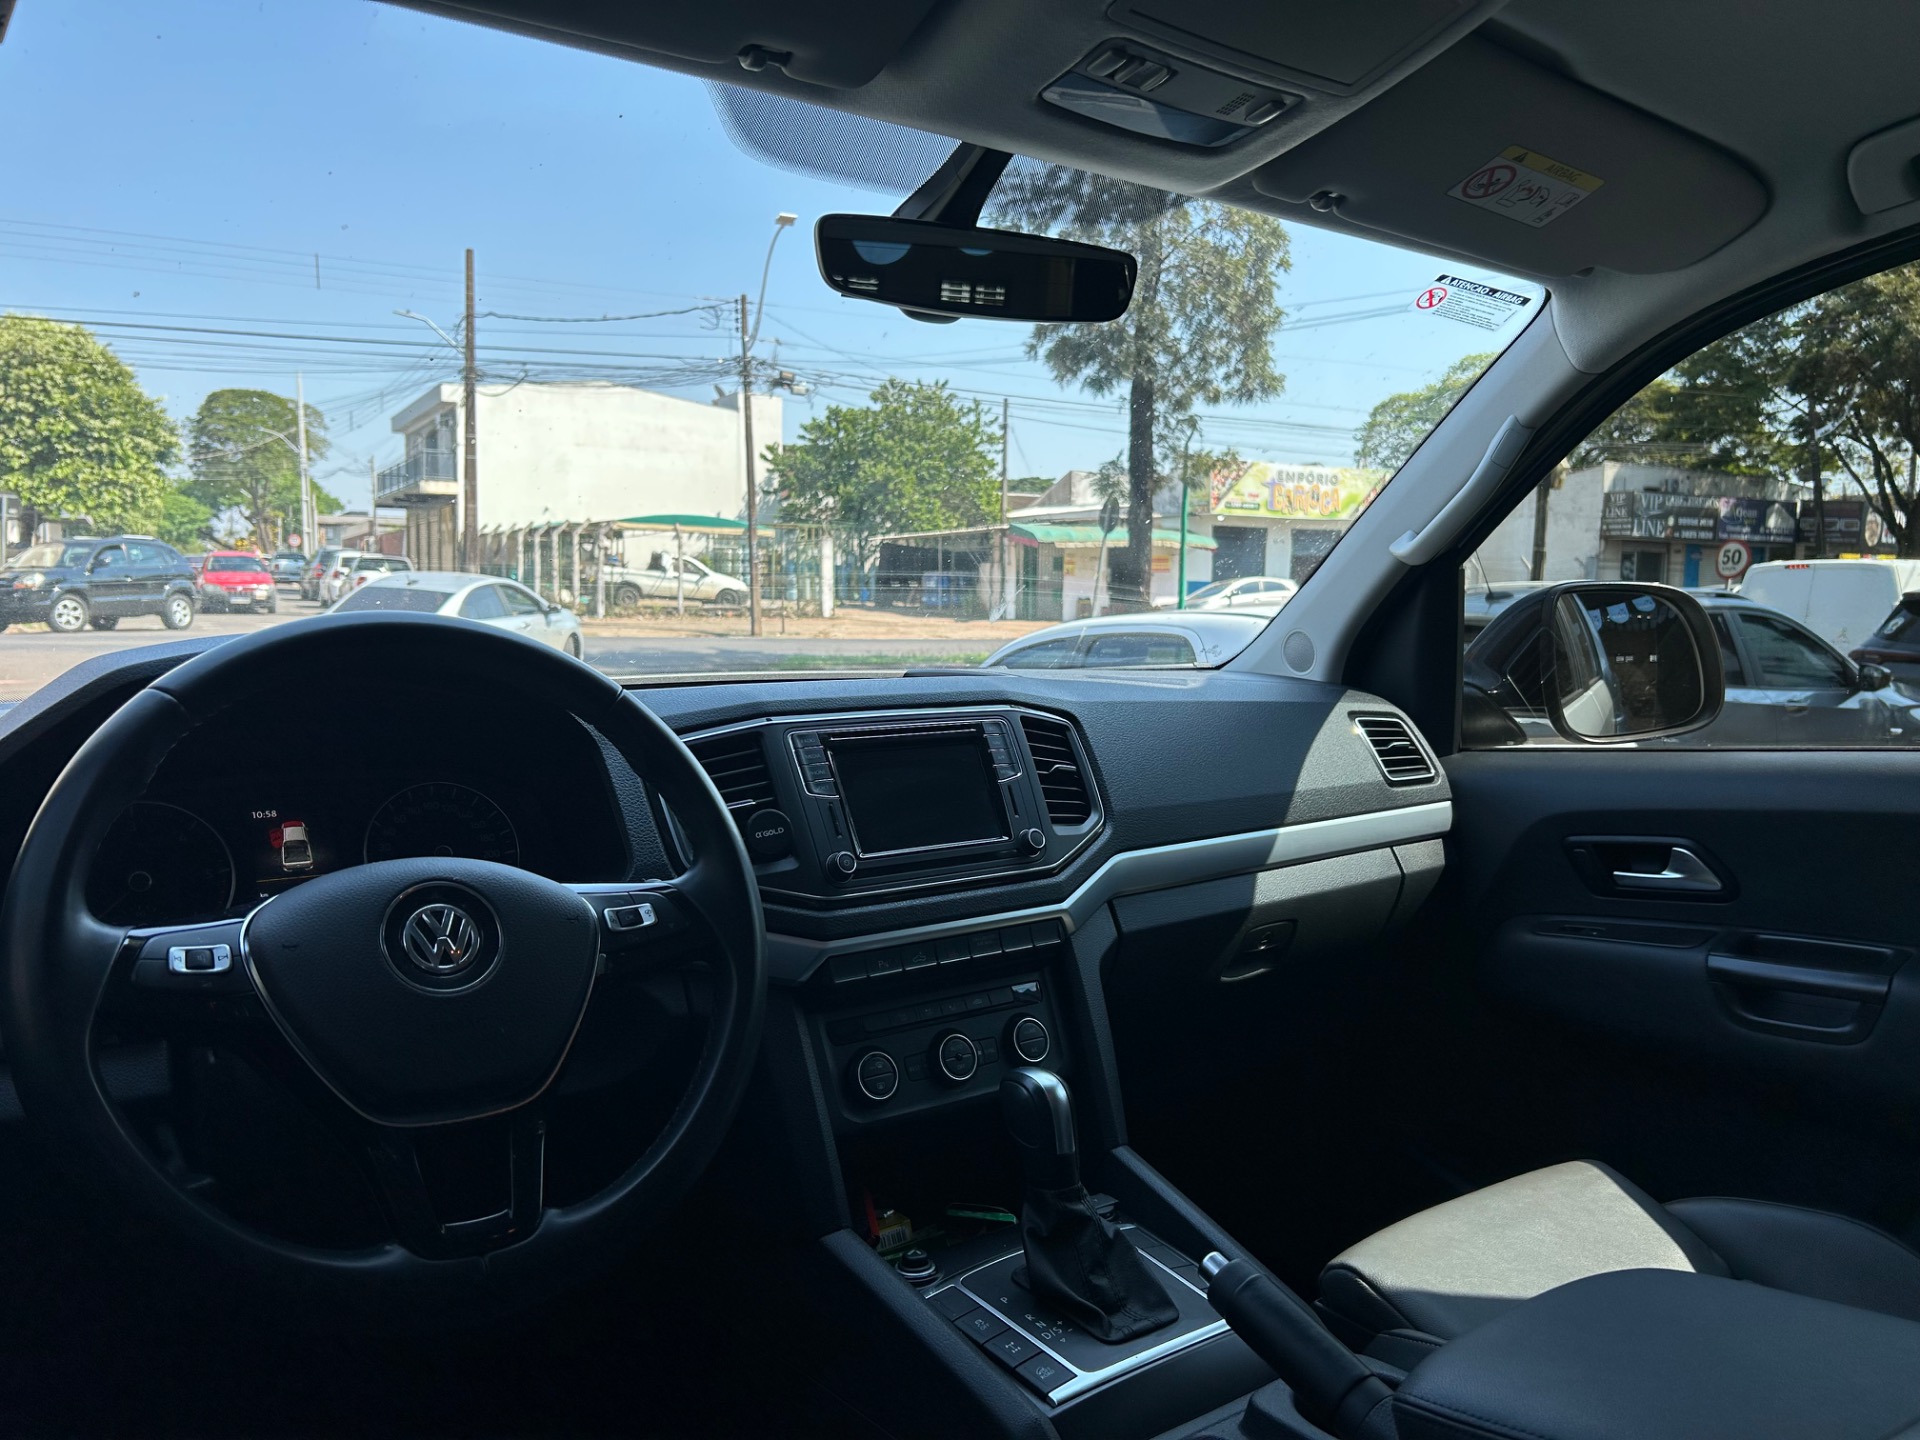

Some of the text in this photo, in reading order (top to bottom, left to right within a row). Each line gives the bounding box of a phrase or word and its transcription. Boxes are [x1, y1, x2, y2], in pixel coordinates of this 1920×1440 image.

[1543, 163, 1582, 182] AIRBAG
[1493, 291, 1524, 305] AIRBAG
[1273, 482, 1341, 516] CARIOCA
[1640, 493, 1663, 511] VIP
[1722, 549, 1742, 565] 50
[251, 809, 278, 819] 10:58
[1000, 1296, 1009, 1304] P
[1025, 1313, 1036, 1321] R
[1035, 1320, 1047, 1329] N
